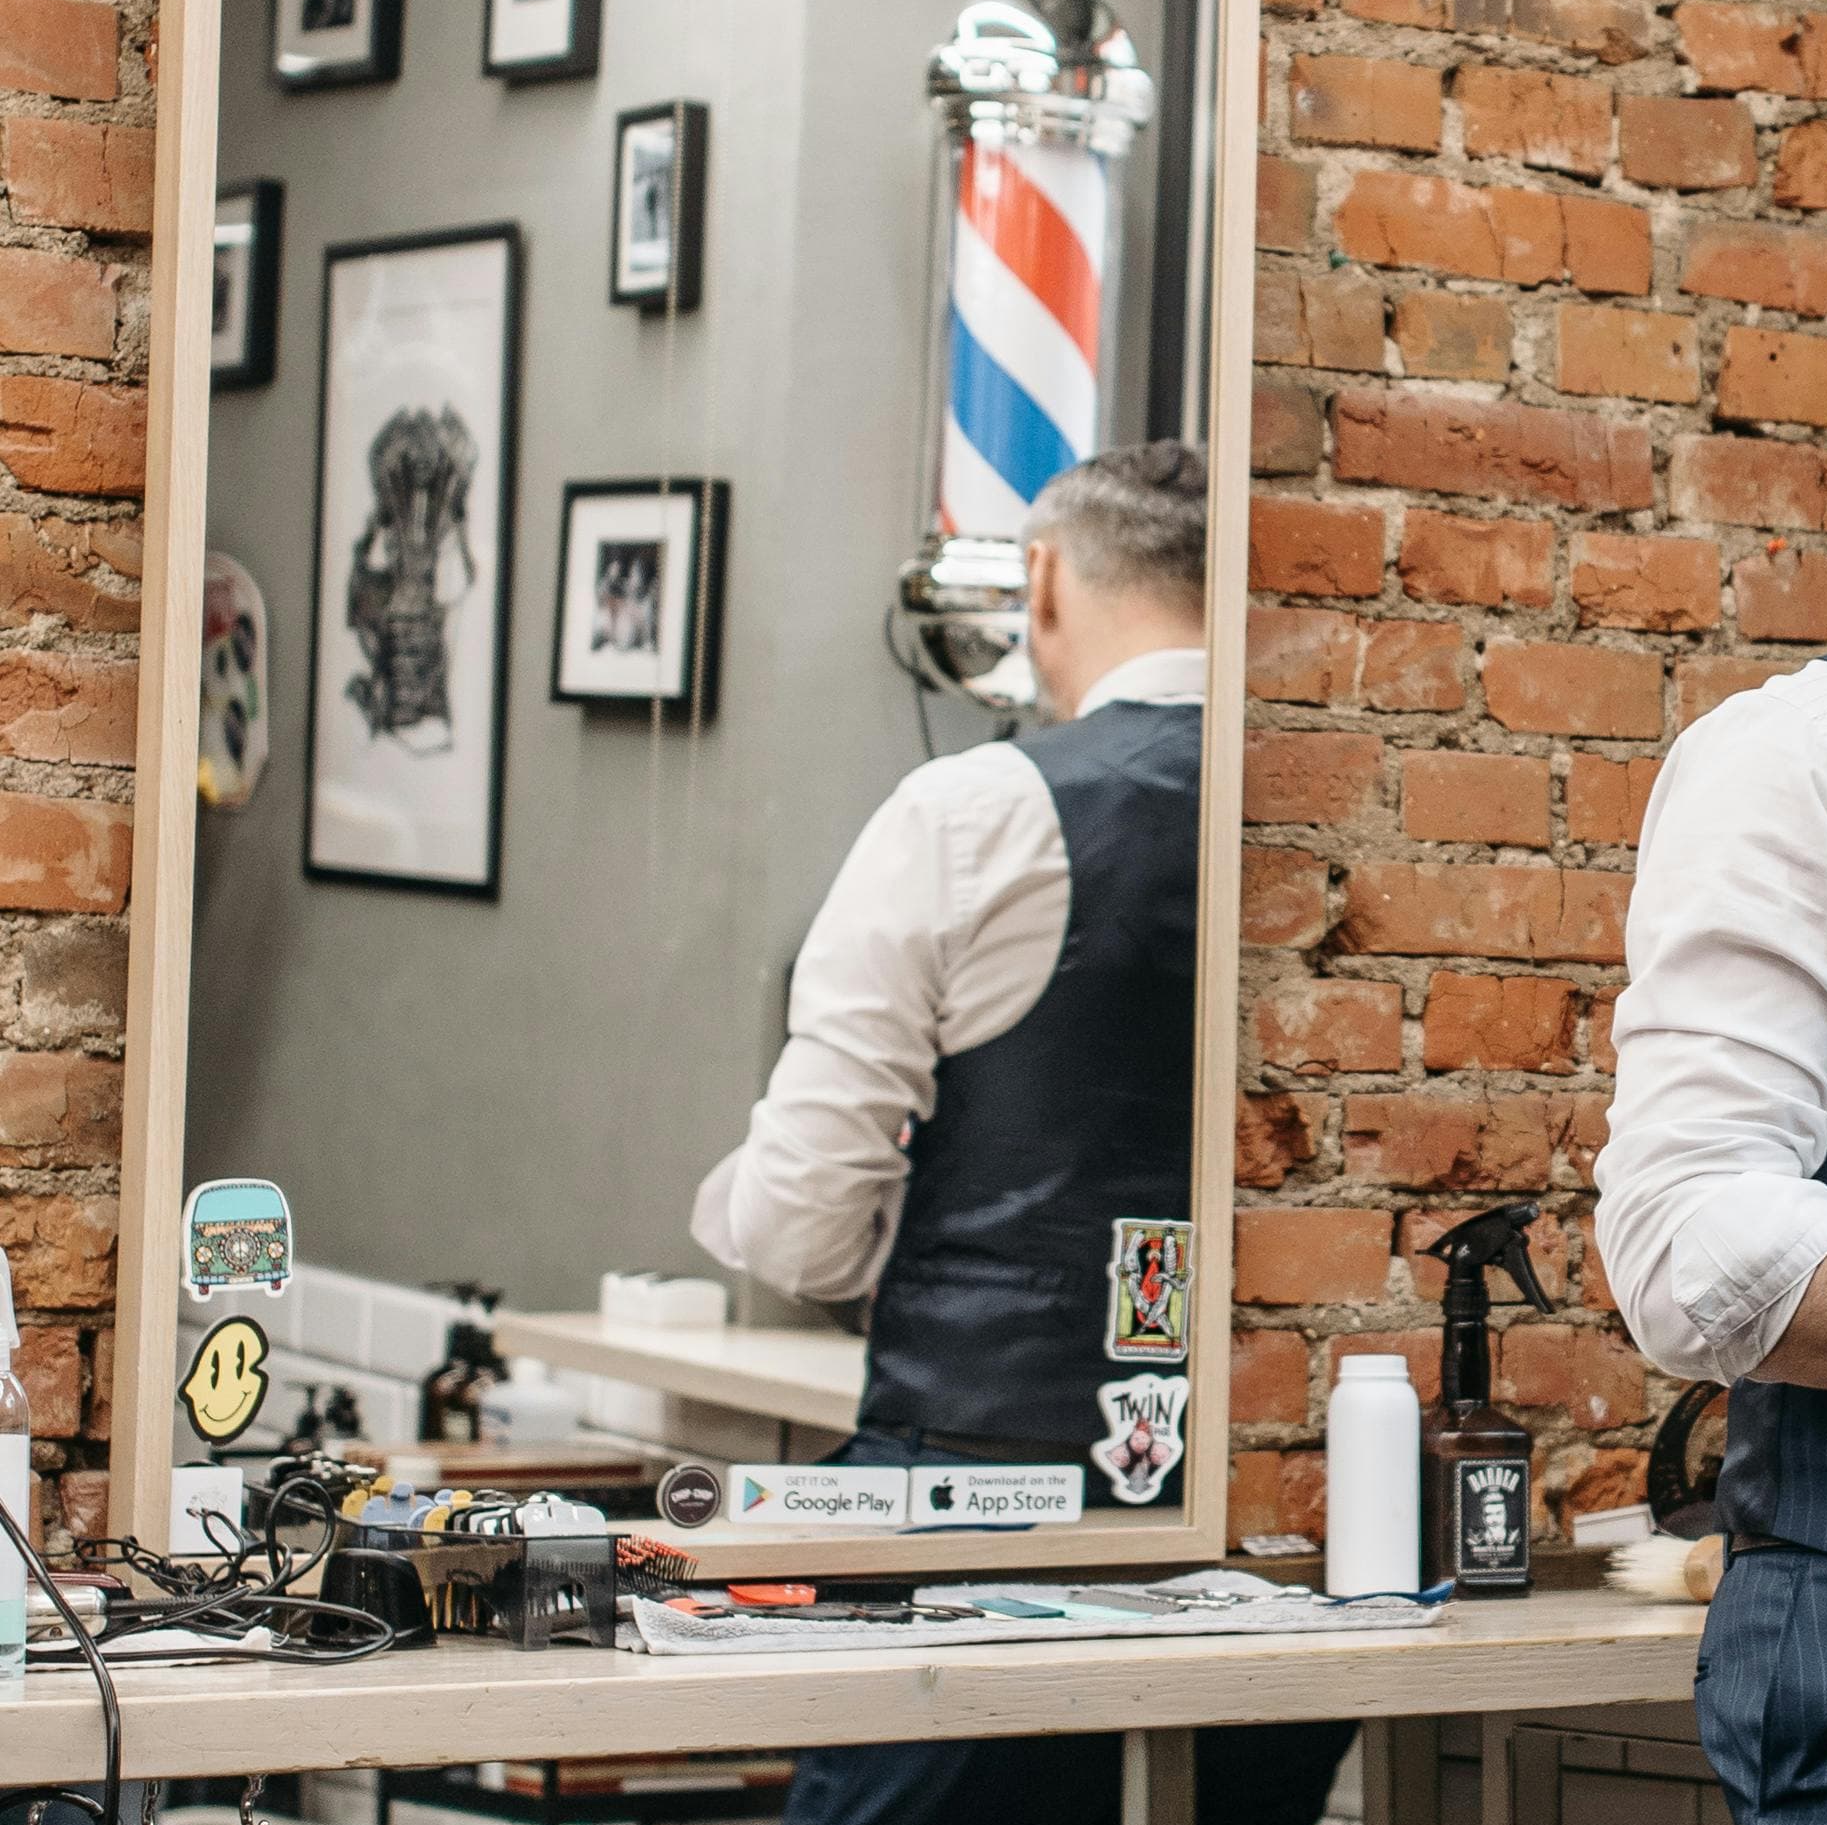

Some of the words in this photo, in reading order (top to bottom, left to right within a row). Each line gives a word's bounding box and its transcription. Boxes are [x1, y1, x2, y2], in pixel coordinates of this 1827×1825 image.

[784, 1475, 807, 1487] GET
[809, 1475, 819, 1486] IT
[820, 1475, 839, 1487] ON
[967, 1475, 1027, 1487] Download
[1030, 1477, 1045, 1486] on
[1048, 1475, 1067, 1486] the
[784, 1490, 853, 1517] Google
[856, 1492, 895, 1516] Play
[966, 1492, 1009, 1516] App
[1013, 1491, 1067, 1511] Store
